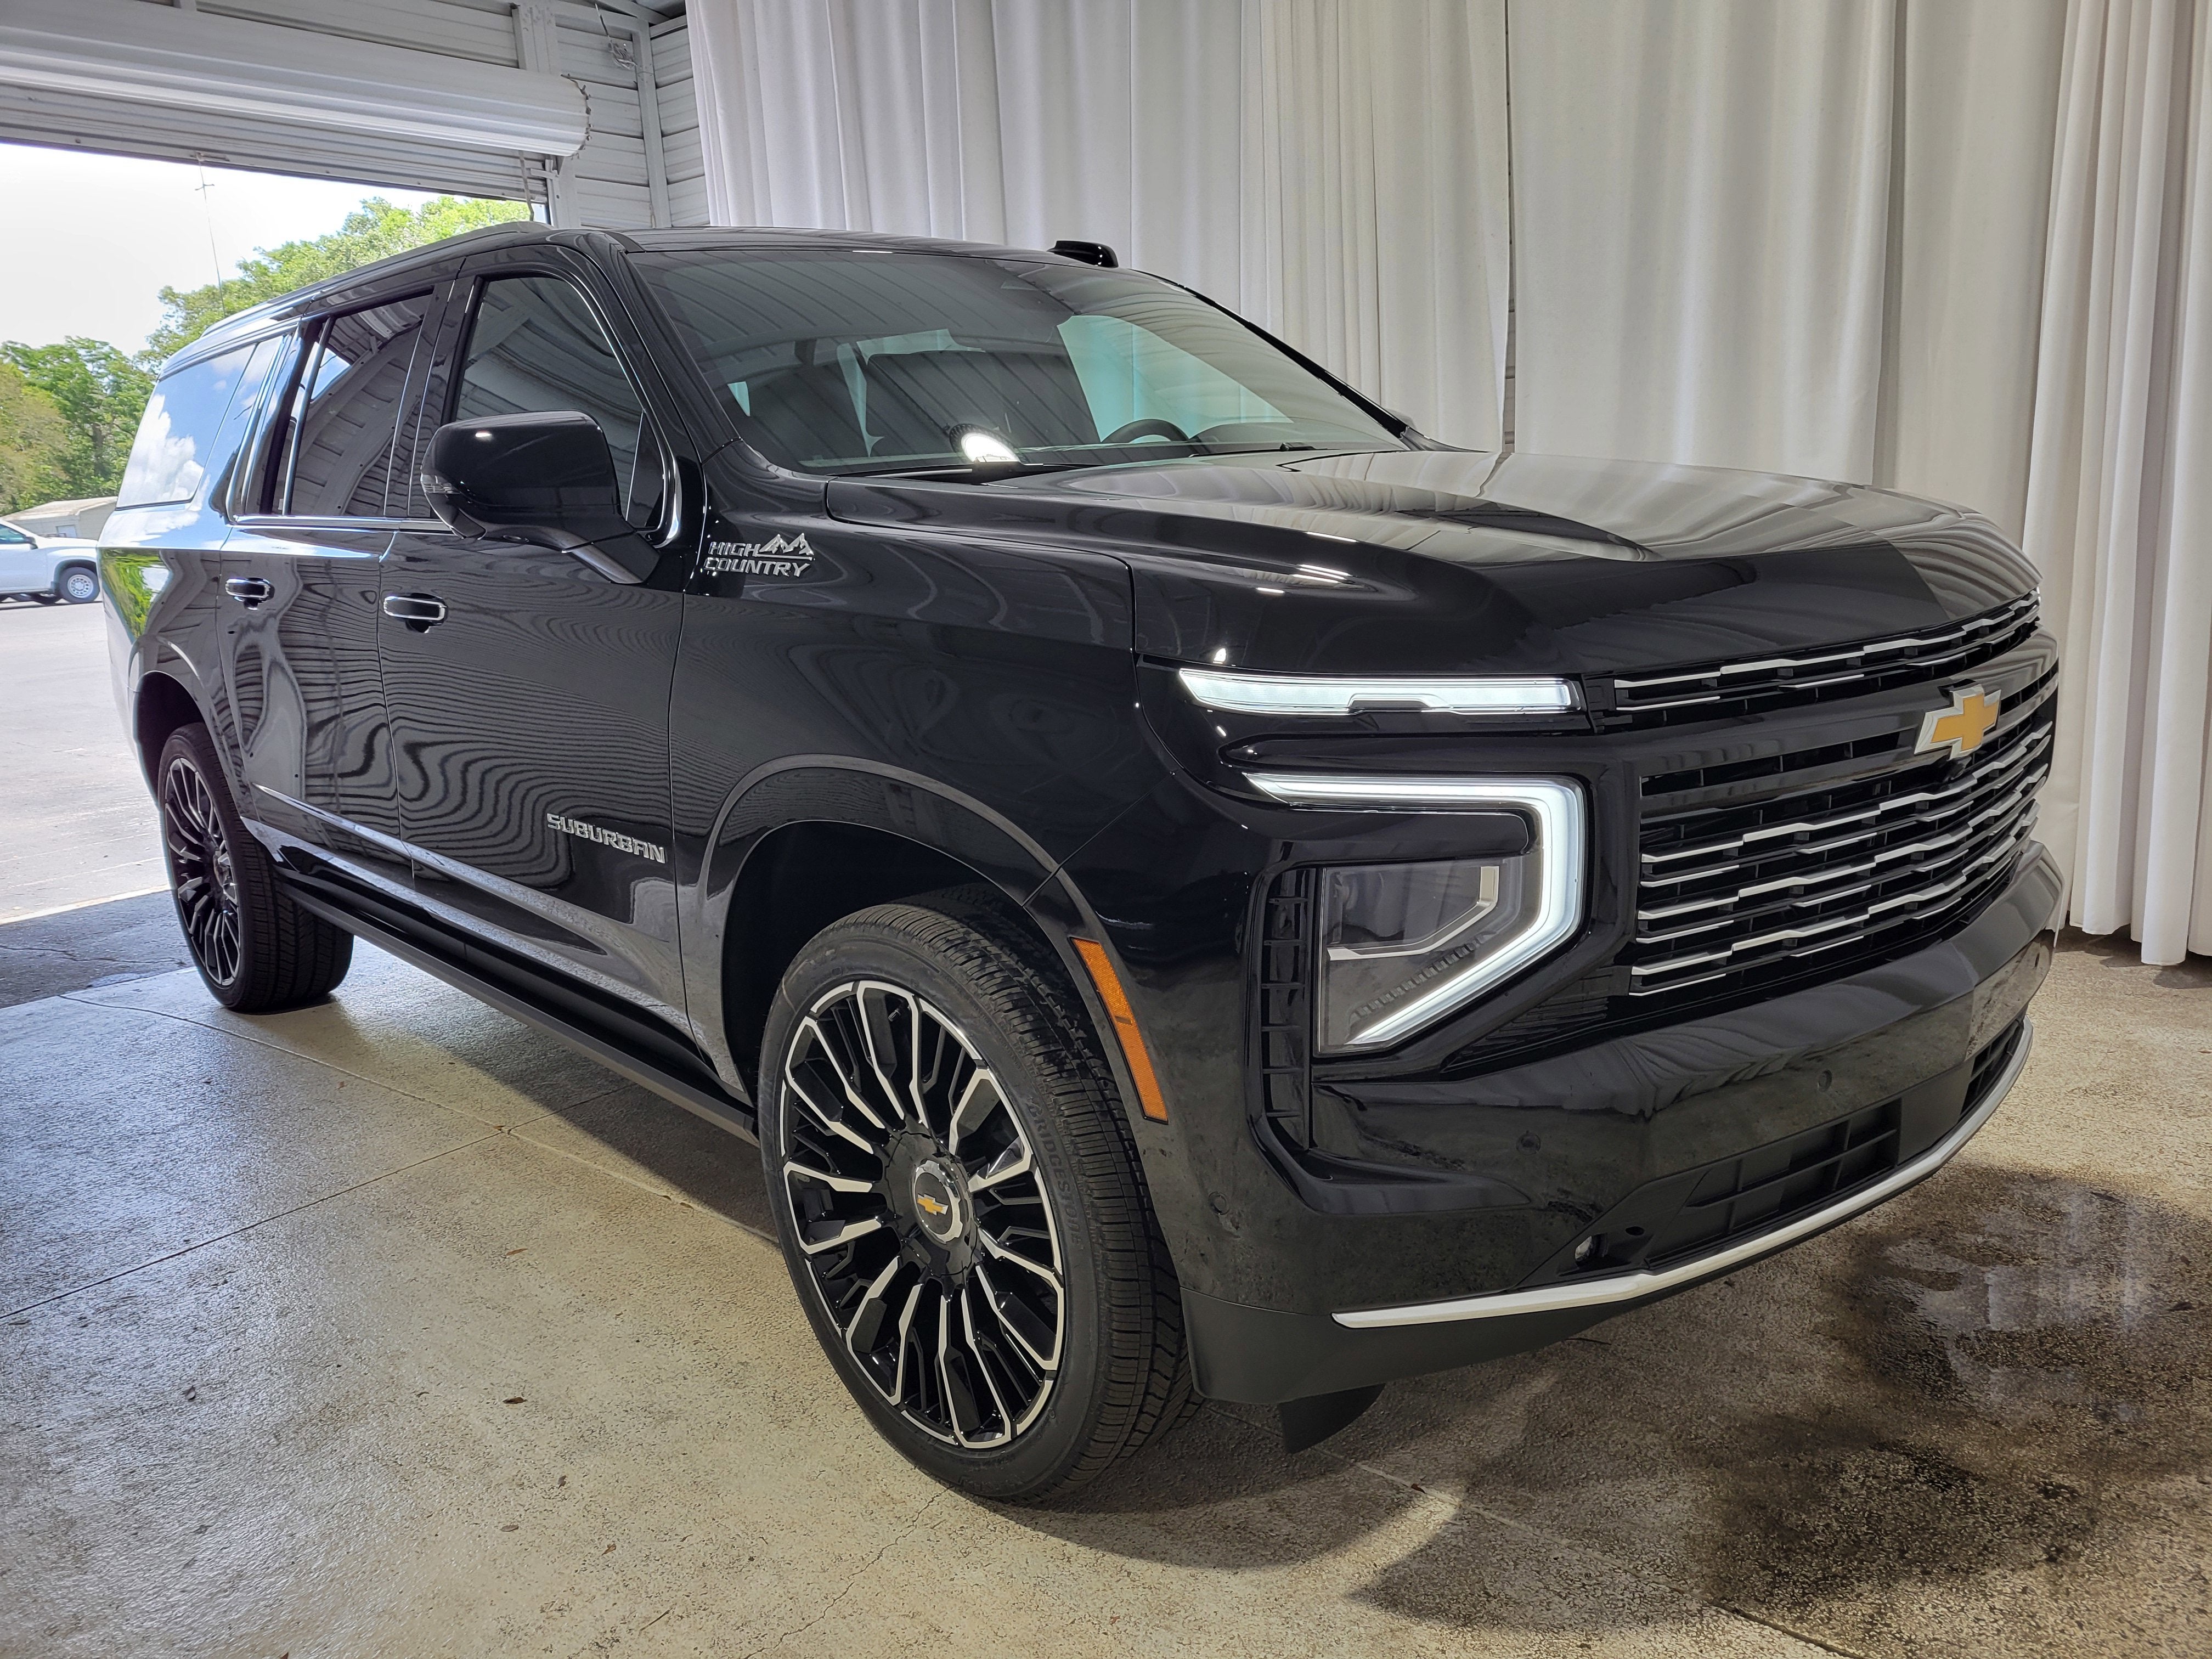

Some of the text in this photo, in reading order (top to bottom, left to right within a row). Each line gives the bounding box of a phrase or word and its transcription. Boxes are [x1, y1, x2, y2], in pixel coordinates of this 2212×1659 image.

[708, 541, 761, 557] HIGH
[704, 556, 810, 577] COUNTRY
[546, 812, 665, 864] SUBURBAN
